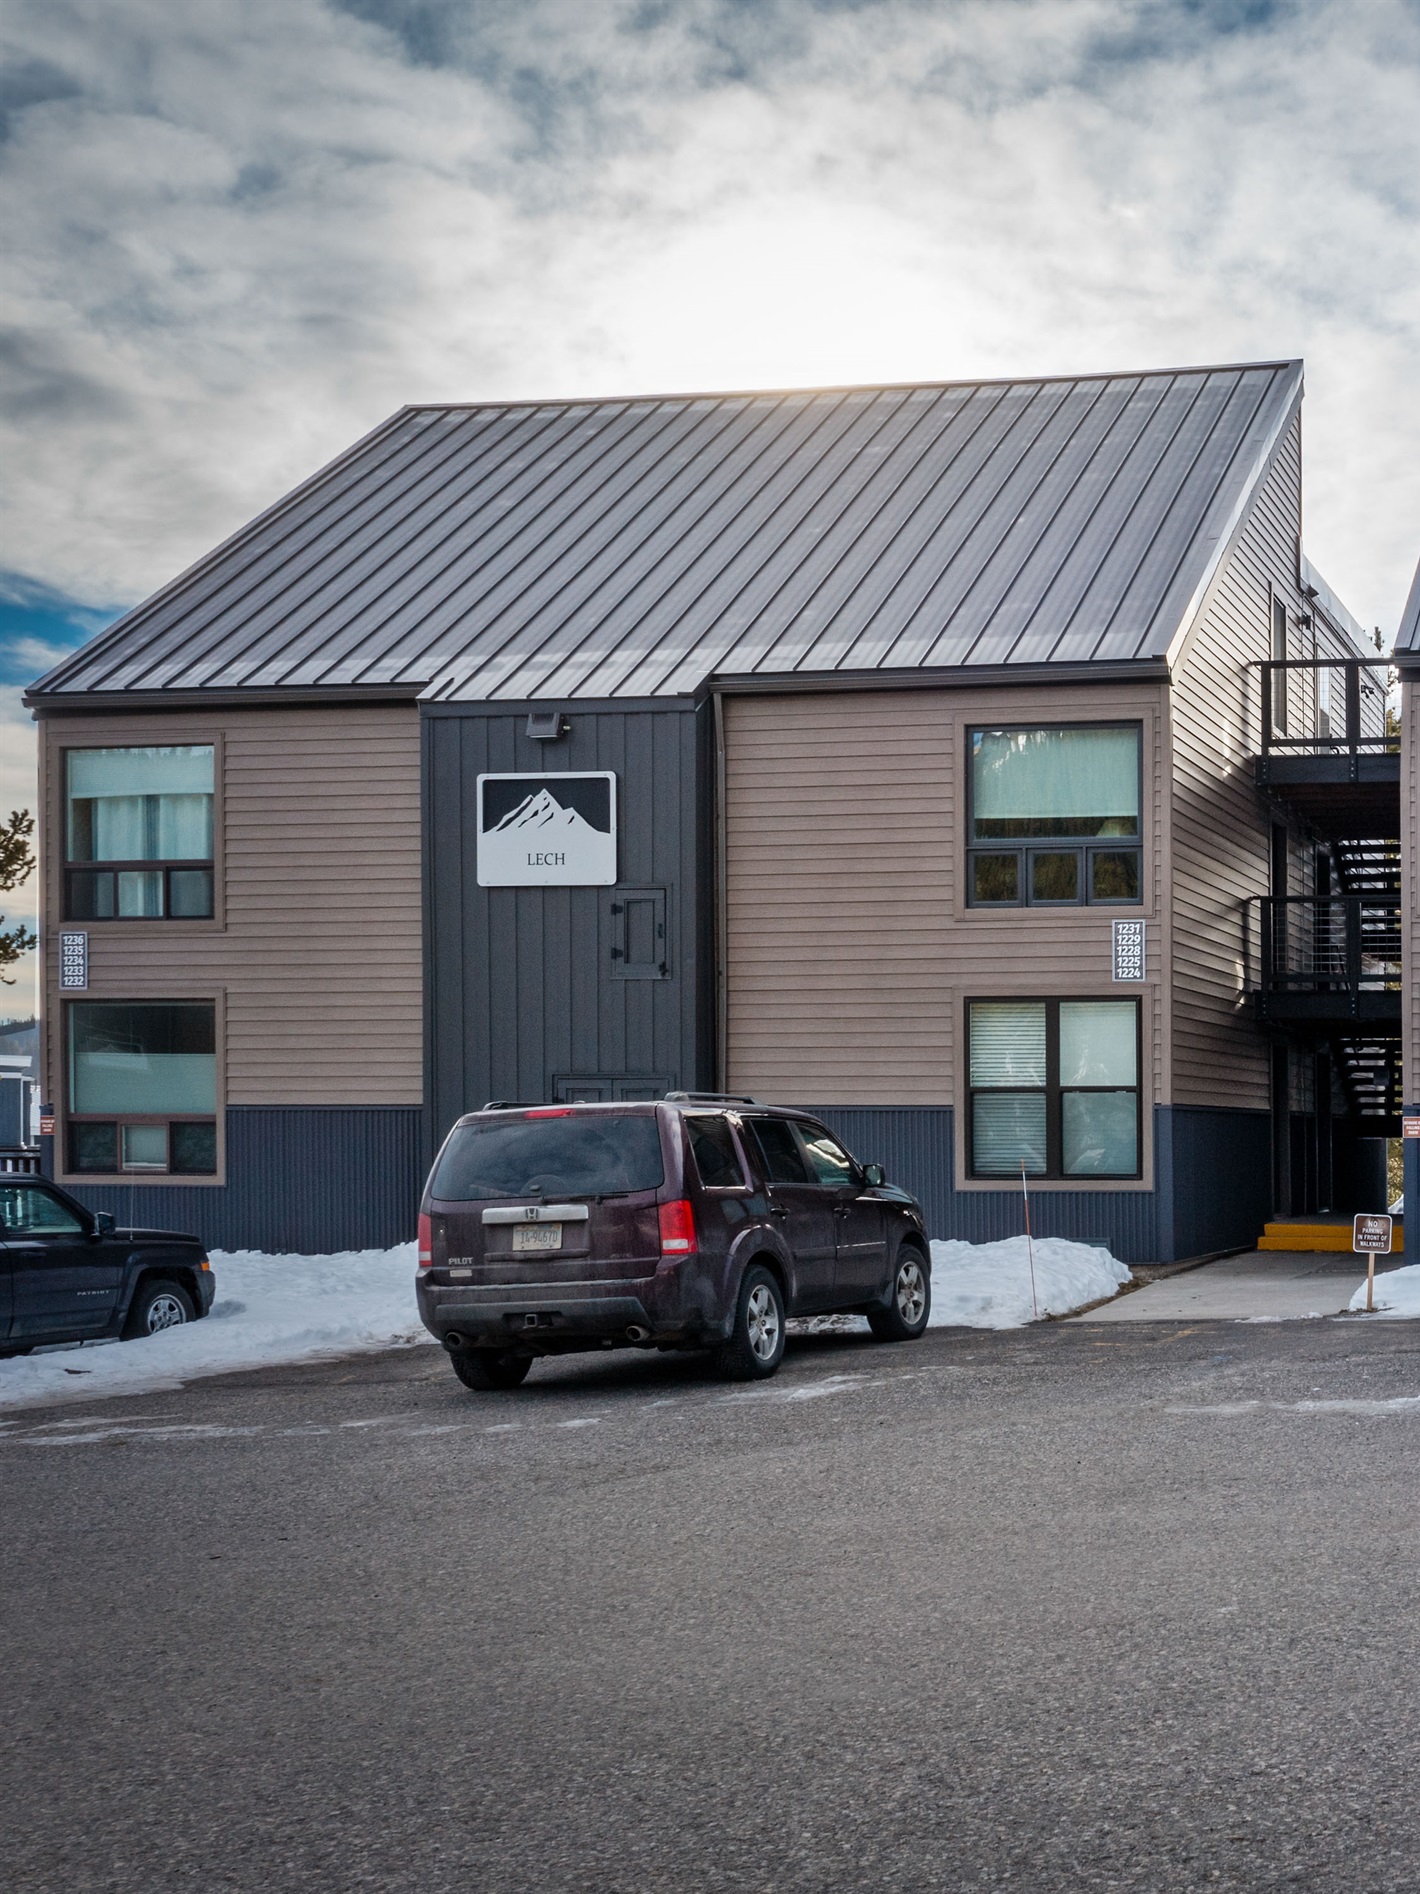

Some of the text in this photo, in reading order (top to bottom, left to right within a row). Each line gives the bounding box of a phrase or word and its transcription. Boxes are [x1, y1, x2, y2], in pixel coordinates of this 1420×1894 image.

[527, 853, 566, 866] LECH
[1117, 924, 1141, 934] 1231
[63, 935, 84, 945] 1236
[1117, 935, 1141, 945] 1229
[63, 946, 84, 955] 1235
[1117, 946, 1141, 956] 1228
[63, 956, 84, 965] 1234
[1117, 957, 1141, 967] 1225
[63, 966, 84, 975] 1233
[1117, 968, 1141, 978] 1224
[63, 976, 84, 986] 1232
[1367, 1220, 1378, 1228] NO
[448, 1256, 474, 1266] PILOT
